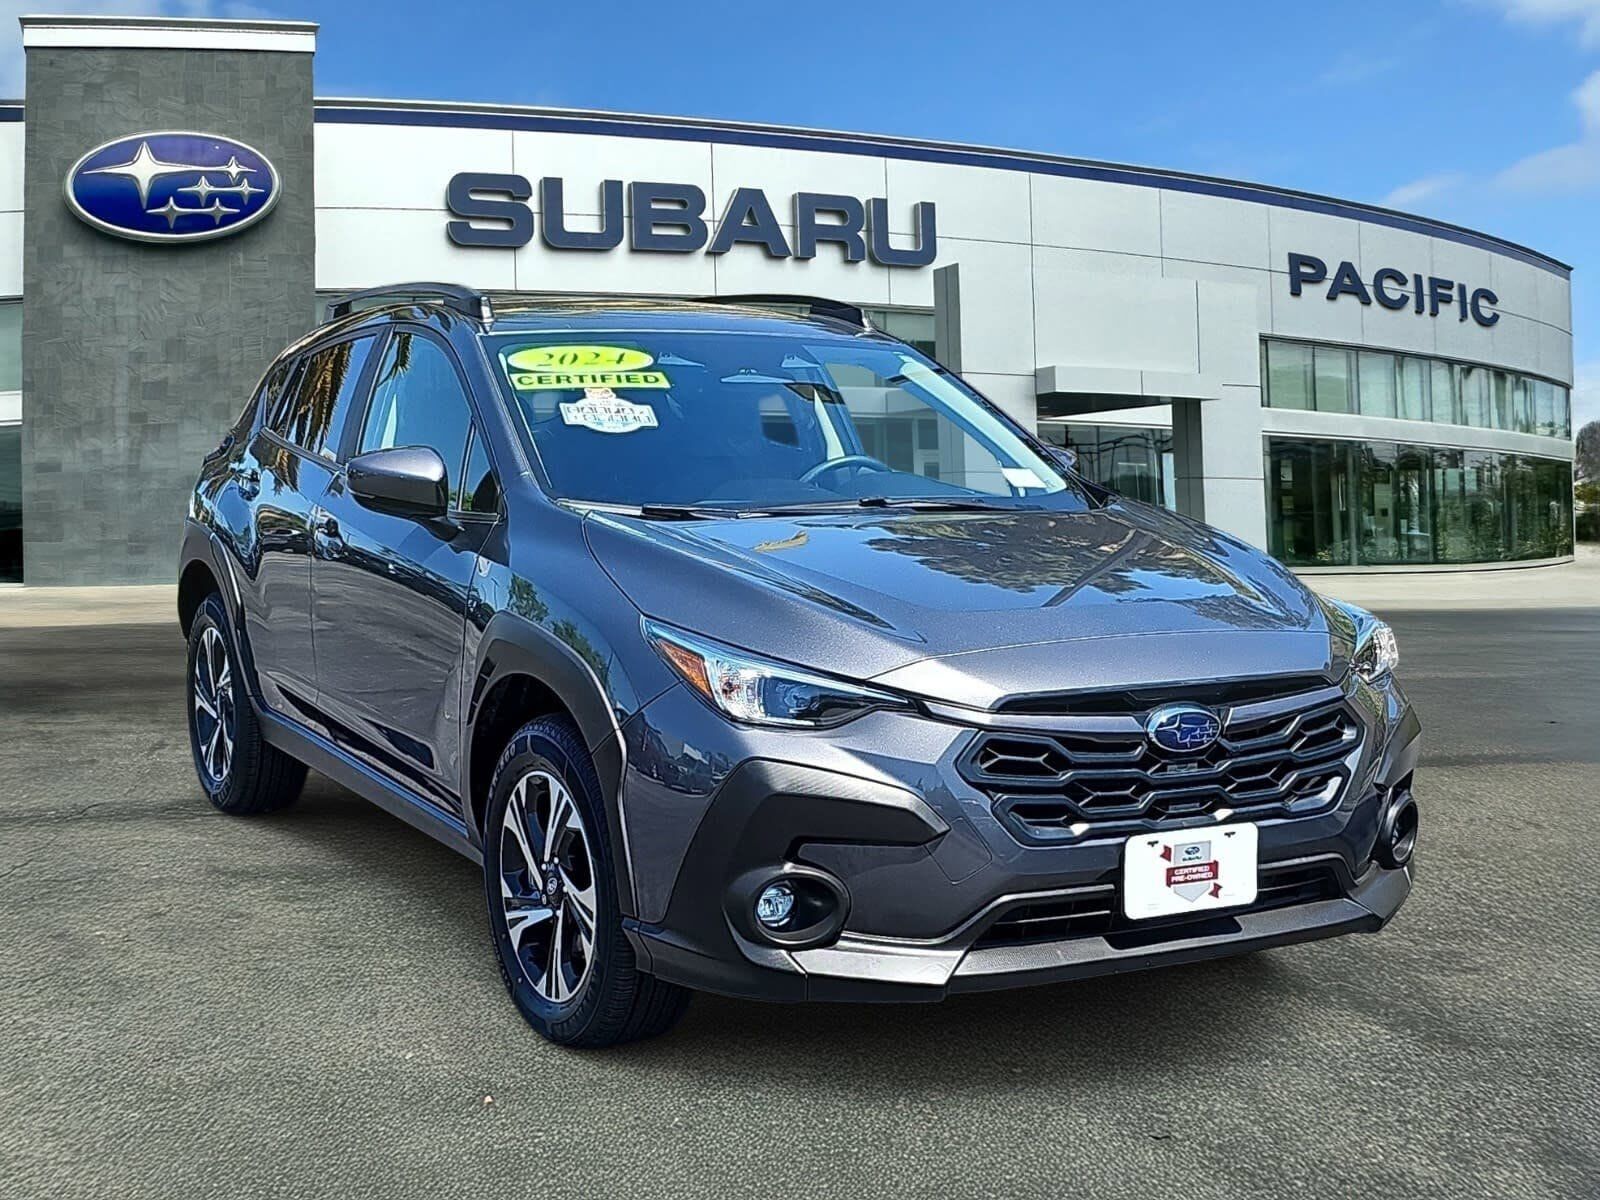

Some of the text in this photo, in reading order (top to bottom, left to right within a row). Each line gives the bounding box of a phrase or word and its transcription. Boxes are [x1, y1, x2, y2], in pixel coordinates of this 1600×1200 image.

[446, 171, 938, 268] SUBARU
[1287, 251, 1501, 328] PACIFIC
[536, 351, 627, 368] 2024
[517, 374, 660, 386] CERTIFIED
[1174, 865, 1210, 875] CERTIFIED
[1171, 872, 1214, 883] PRE-OWNED
